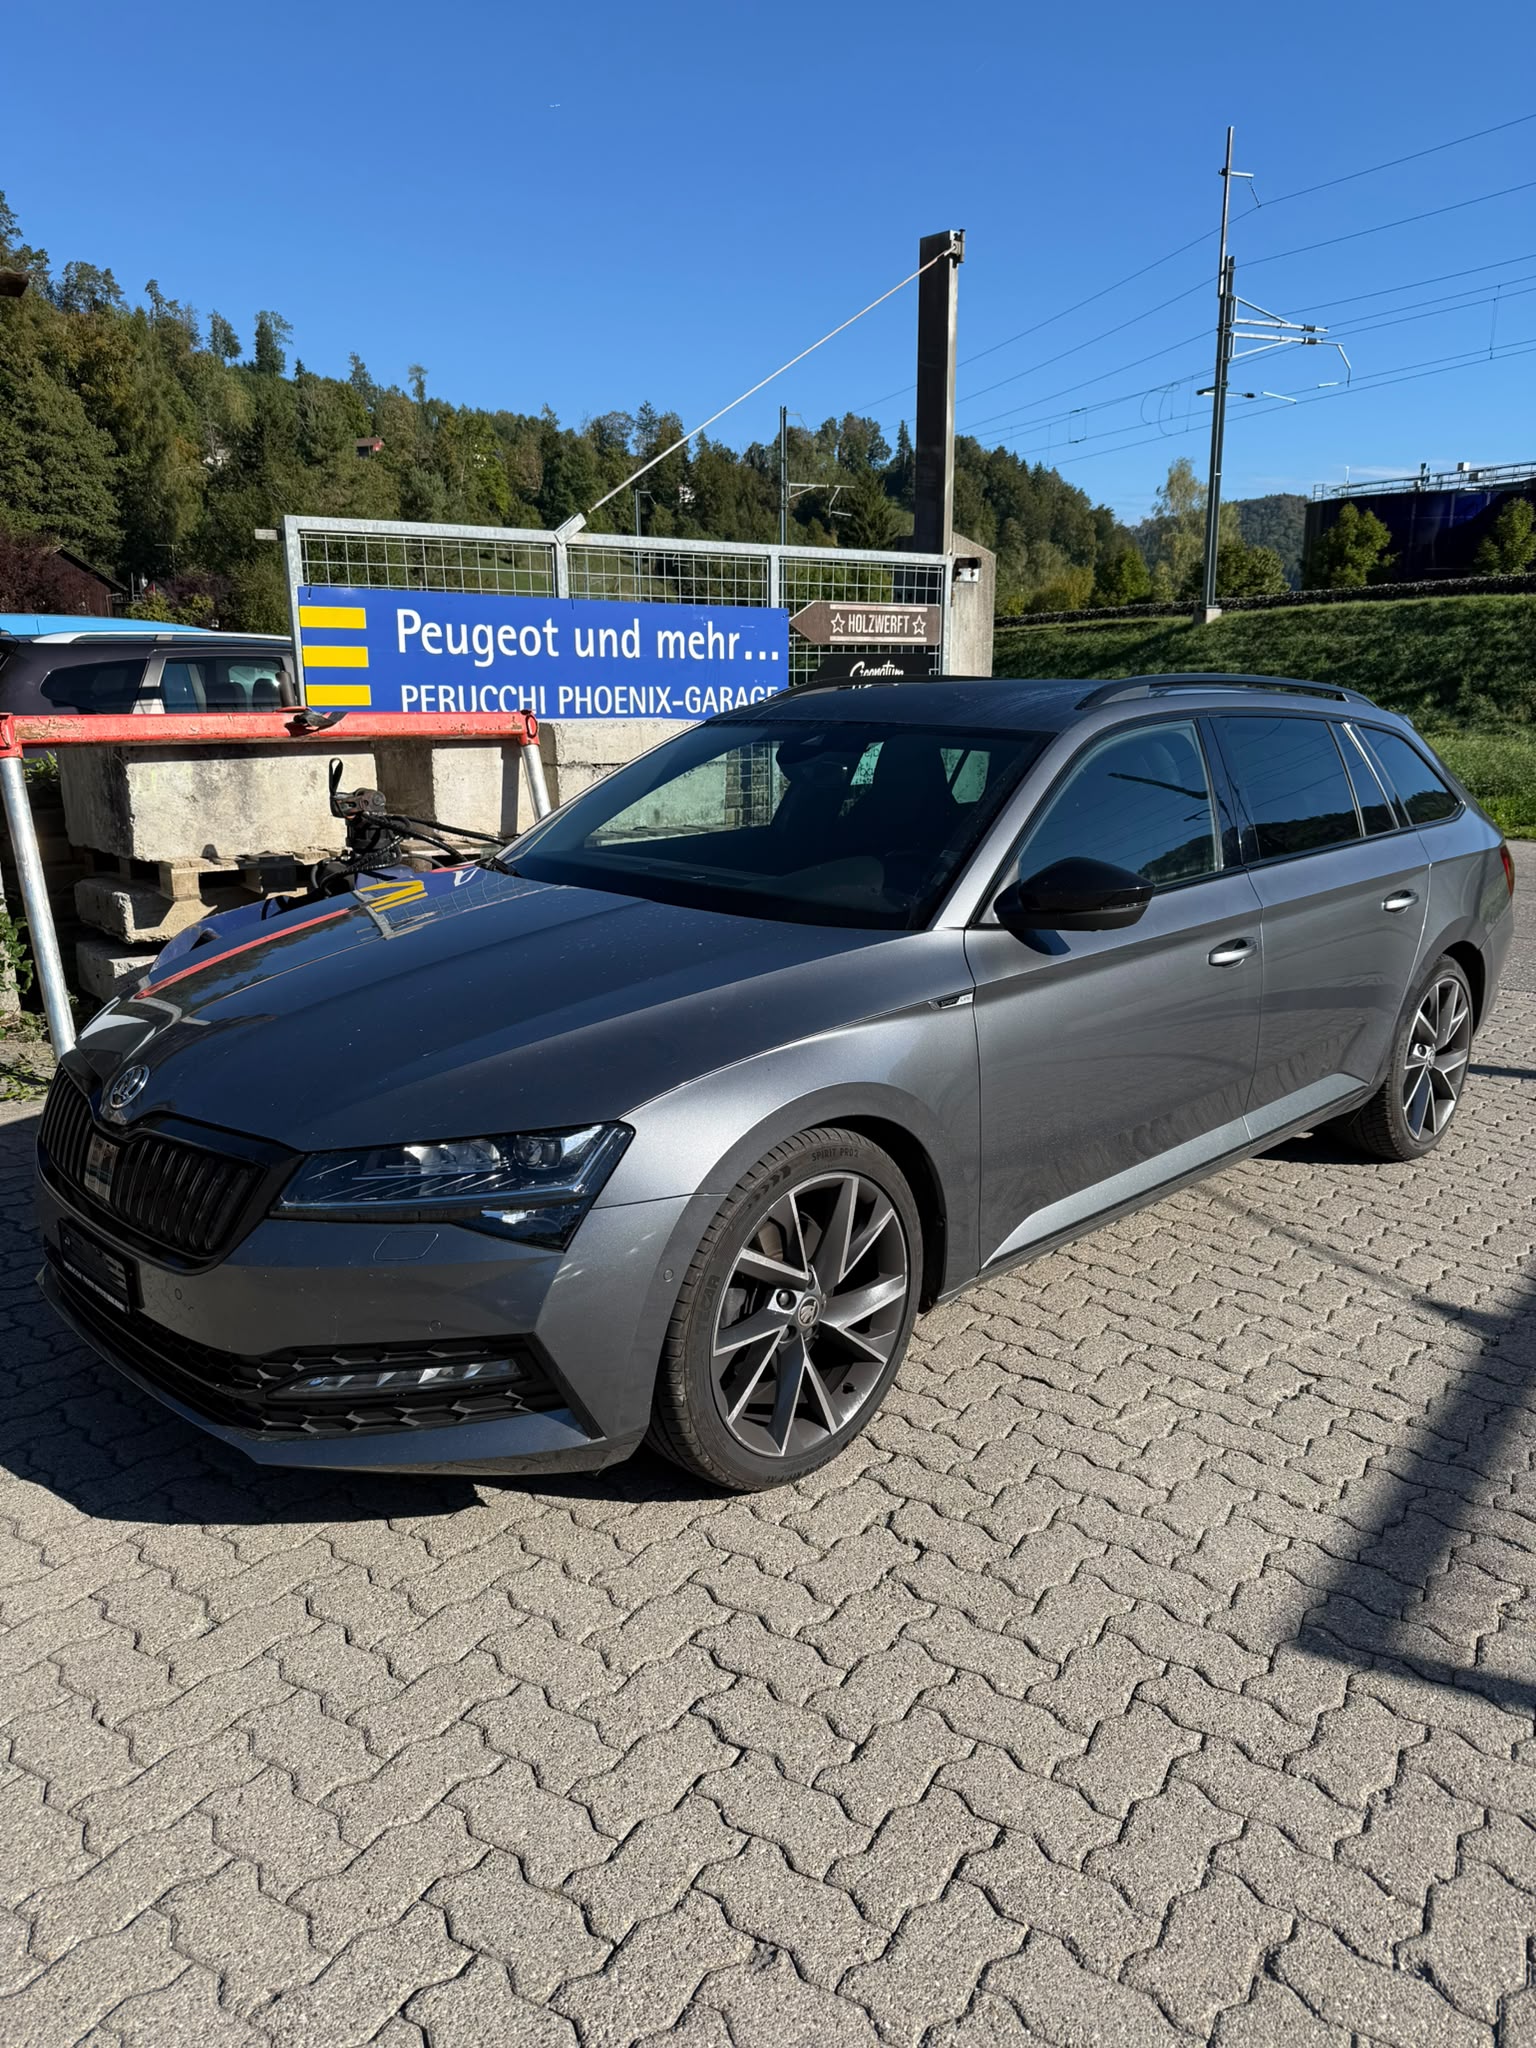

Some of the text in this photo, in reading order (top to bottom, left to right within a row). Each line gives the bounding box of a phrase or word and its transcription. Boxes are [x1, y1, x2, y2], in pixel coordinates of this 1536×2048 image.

[848, 613, 910, 634] HOLZWERFT
[397, 609, 779, 667] Peugeot und mehr...
[401, 685, 545, 714] PERUCCHI
[811, 1148, 837, 1162] SPIRIT
